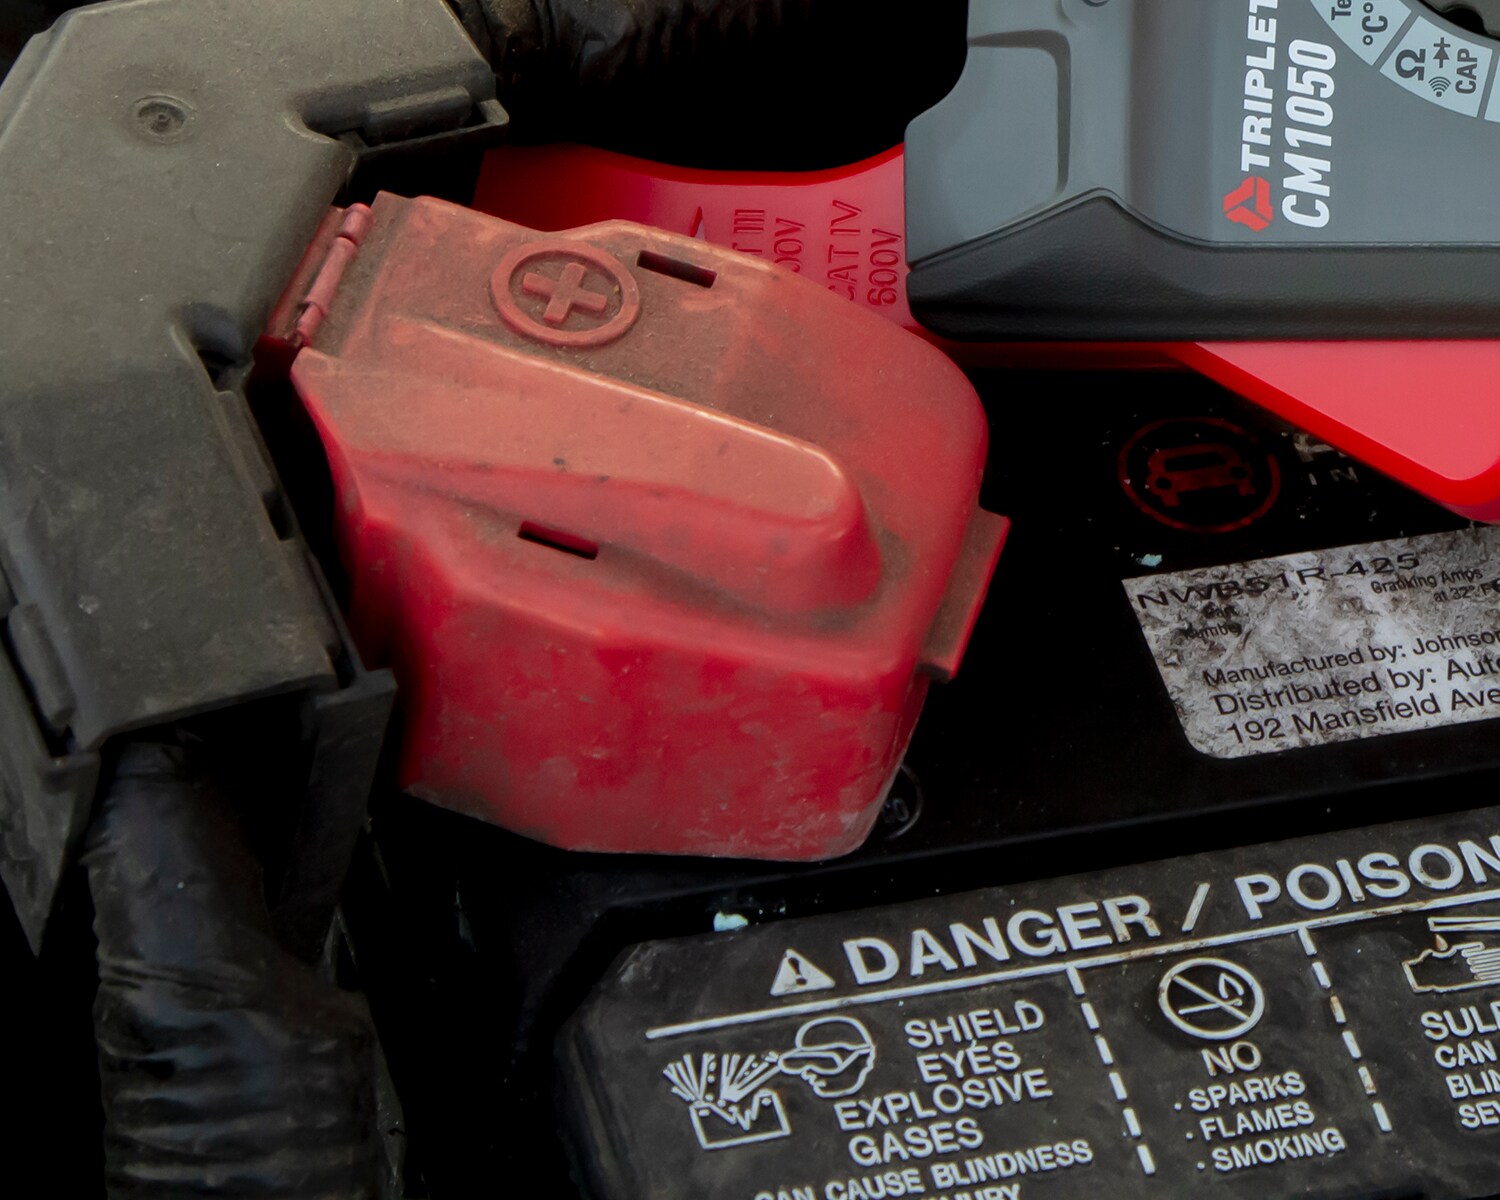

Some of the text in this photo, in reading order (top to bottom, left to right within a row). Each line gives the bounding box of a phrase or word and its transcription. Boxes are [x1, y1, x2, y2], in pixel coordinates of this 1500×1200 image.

[1454, 48, 1479, 95] CAP
[1282, 39, 1337, 229] CM1050
[830, 199, 862, 237] IV
[867, 228, 902, 306] 600V
[1433, 589, 1448, 602] at
[1441, 568, 1484, 584] Amps
[1202, 648, 1364, 687] Manufactured
[1367, 639, 1407, 667] by:
[1214, 669, 1382, 716] Distributed
[1388, 665, 1437, 694] by:
[1226, 719, 1286, 745] 192
[1291, 692, 1443, 740] Mansfield
[843, 894, 1161, 986] DANGER
[904, 1001, 1045, 1049] SHIELD
[916, 1040, 1021, 1084] EYES
[1200, 1041, 1262, 1077] NO
[1434, 1038, 1496, 1070] CAN
[834, 1068, 1053, 1131] EXPLOSIVE
[1188, 1071, 1306, 1113] SPARKS
[848, 1117, 985, 1167] GASES
[1199, 1101, 1315, 1141] FLAMES
[824, 1167, 926, 1200] CAUSE
[930, 1139, 1094, 1190] BLINDNESS
[1211, 1127, 1346, 1173] SMOKING
